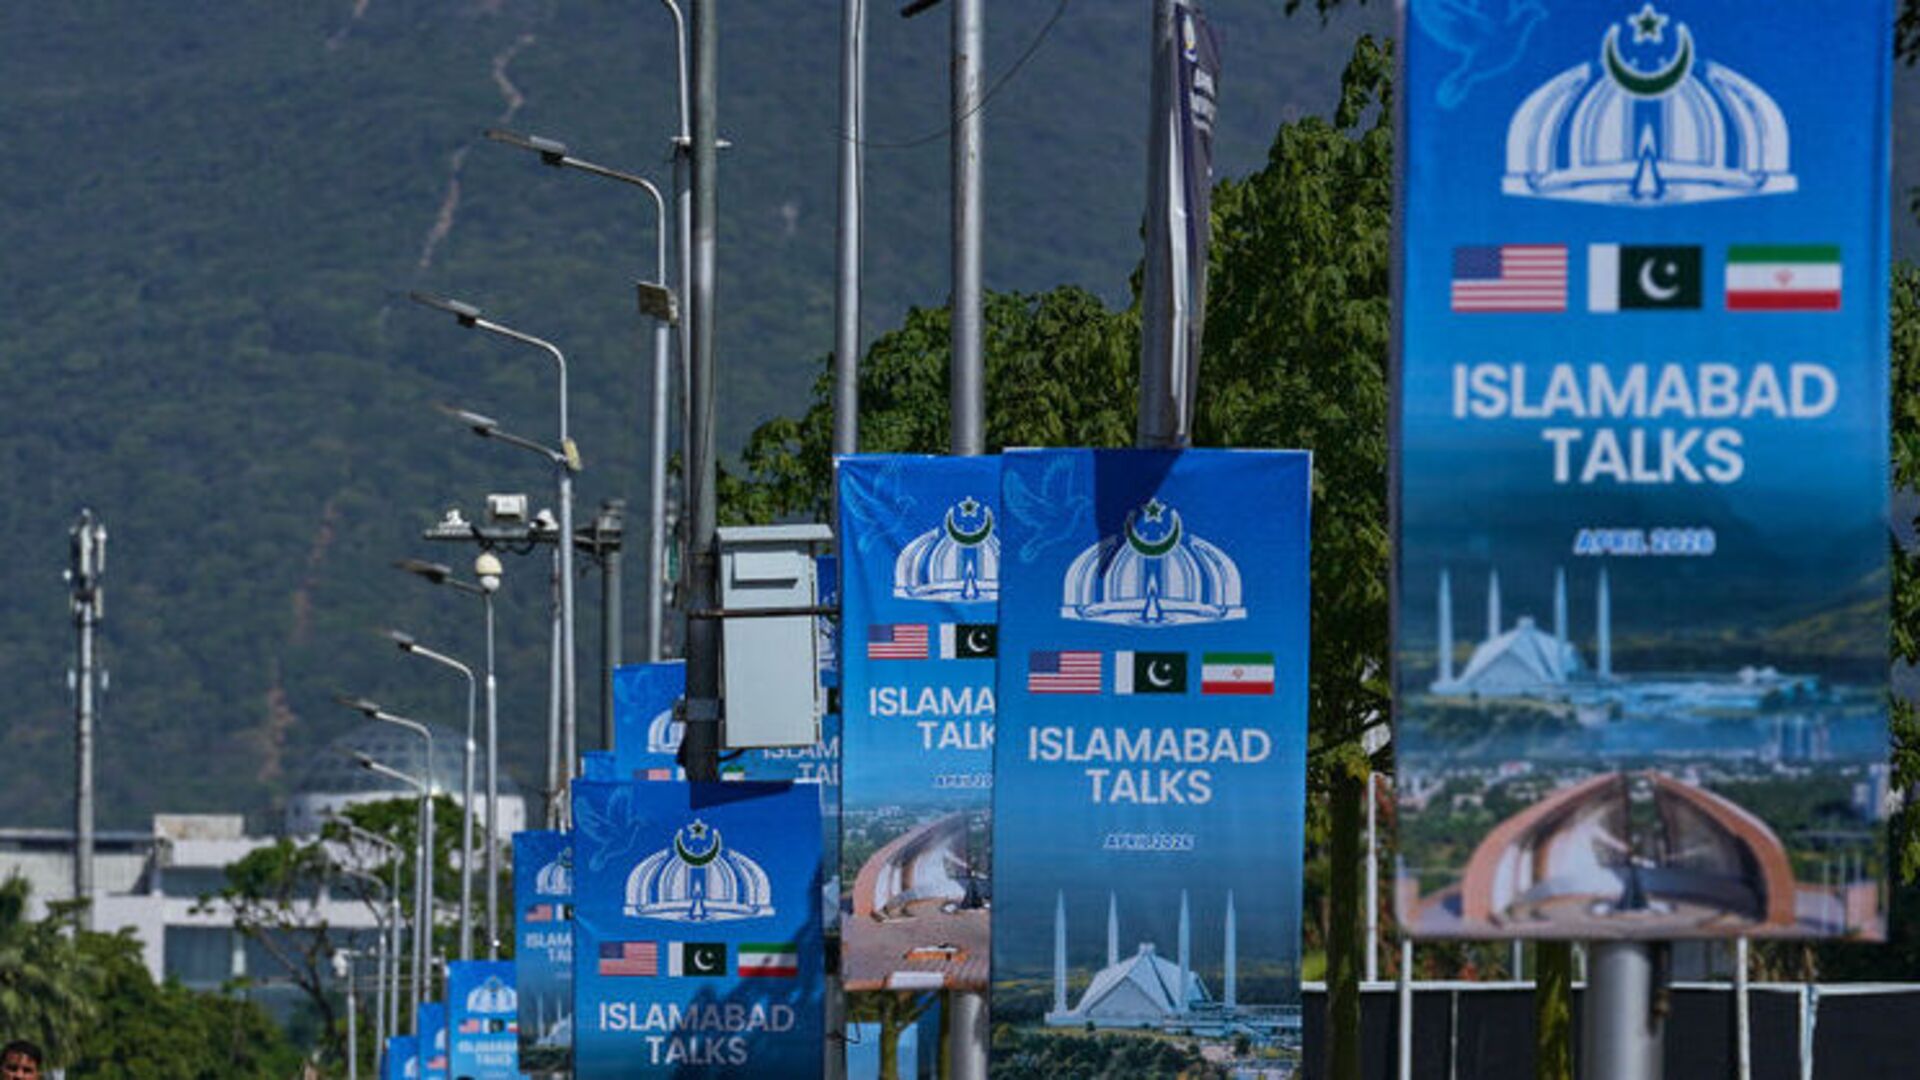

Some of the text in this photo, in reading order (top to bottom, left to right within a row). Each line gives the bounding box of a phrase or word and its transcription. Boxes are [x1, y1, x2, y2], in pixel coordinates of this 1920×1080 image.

[1453, 363, 1838, 419] ISLAMABAD
[1541, 426, 1745, 484] TALKS
[1028, 726, 1272, 763] ISLAMABAD
[1085, 768, 1213, 804] TALKS
[599, 1001, 795, 1032] ISLAMABAD
[645, 1035, 748, 1065] TALKS
